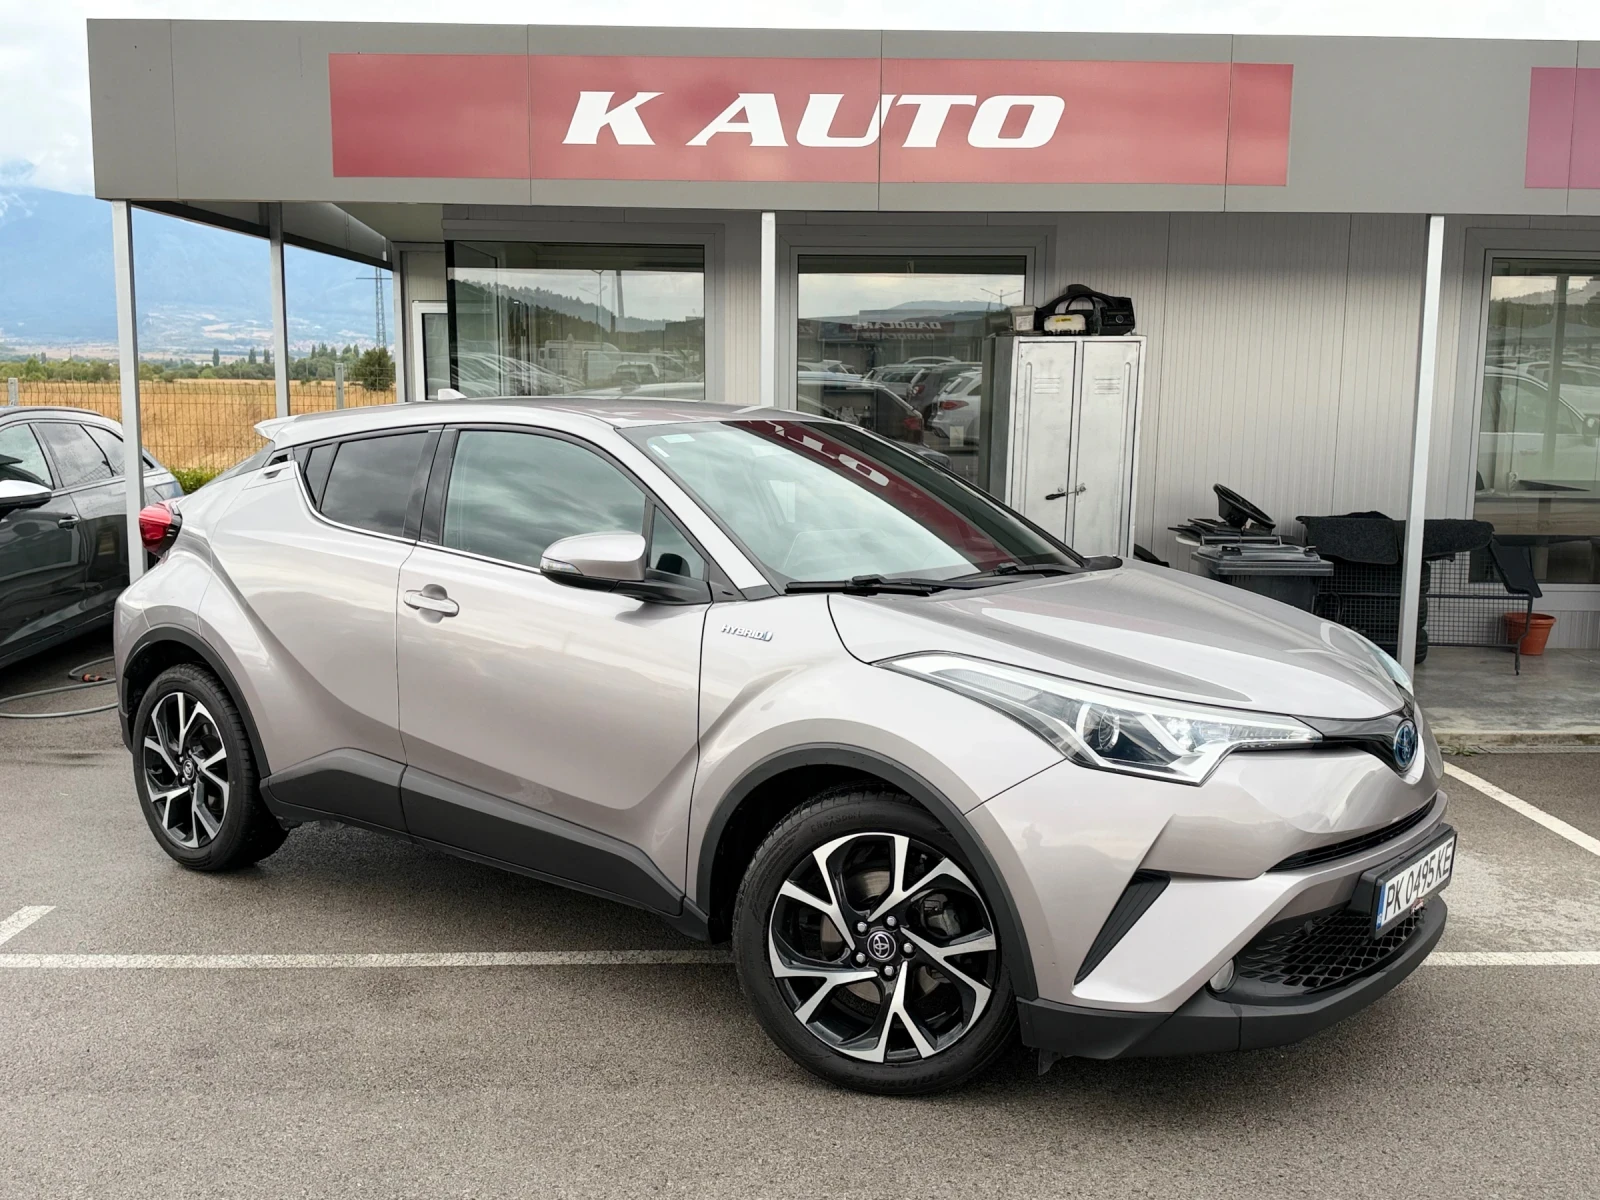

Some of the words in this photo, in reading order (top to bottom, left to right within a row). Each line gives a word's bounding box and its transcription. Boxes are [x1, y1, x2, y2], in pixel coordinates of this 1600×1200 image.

[562, 91, 665, 146] K
[685, 92, 1066, 149] AUTO
[720, 623, 765, 640] HYBRID
[1384, 875, 1405, 921] PK
[1405, 853, 1436, 905] 0495
[1435, 841, 1453, 882] KE
